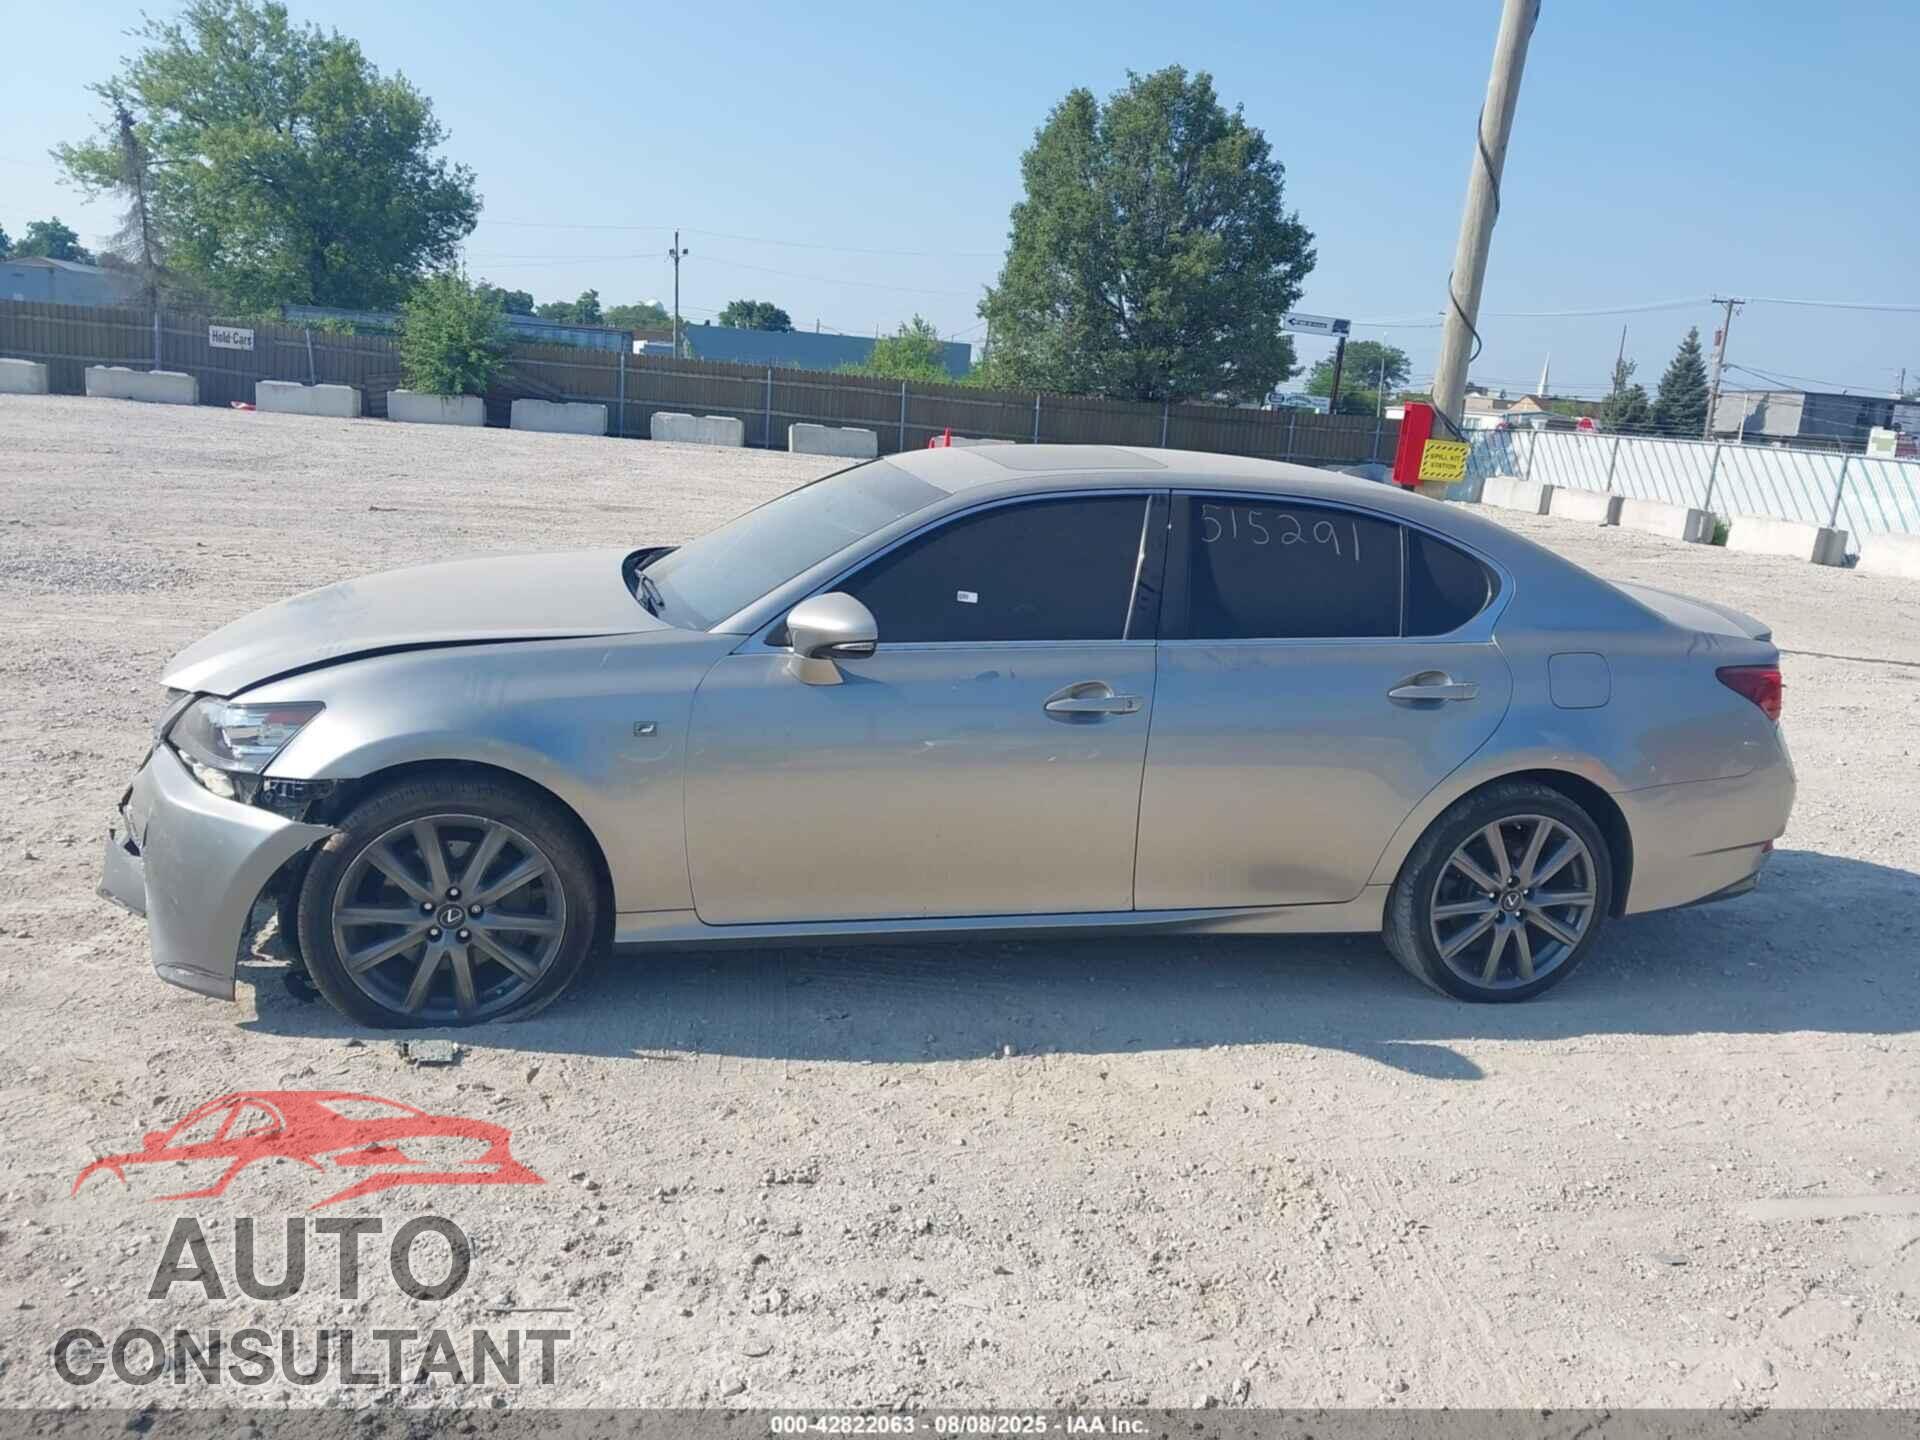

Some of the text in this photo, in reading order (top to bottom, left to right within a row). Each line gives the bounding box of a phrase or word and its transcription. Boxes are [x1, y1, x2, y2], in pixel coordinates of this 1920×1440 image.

[211, 329, 252, 346] Hold Cars
[1201, 503, 1361, 561] 515291
